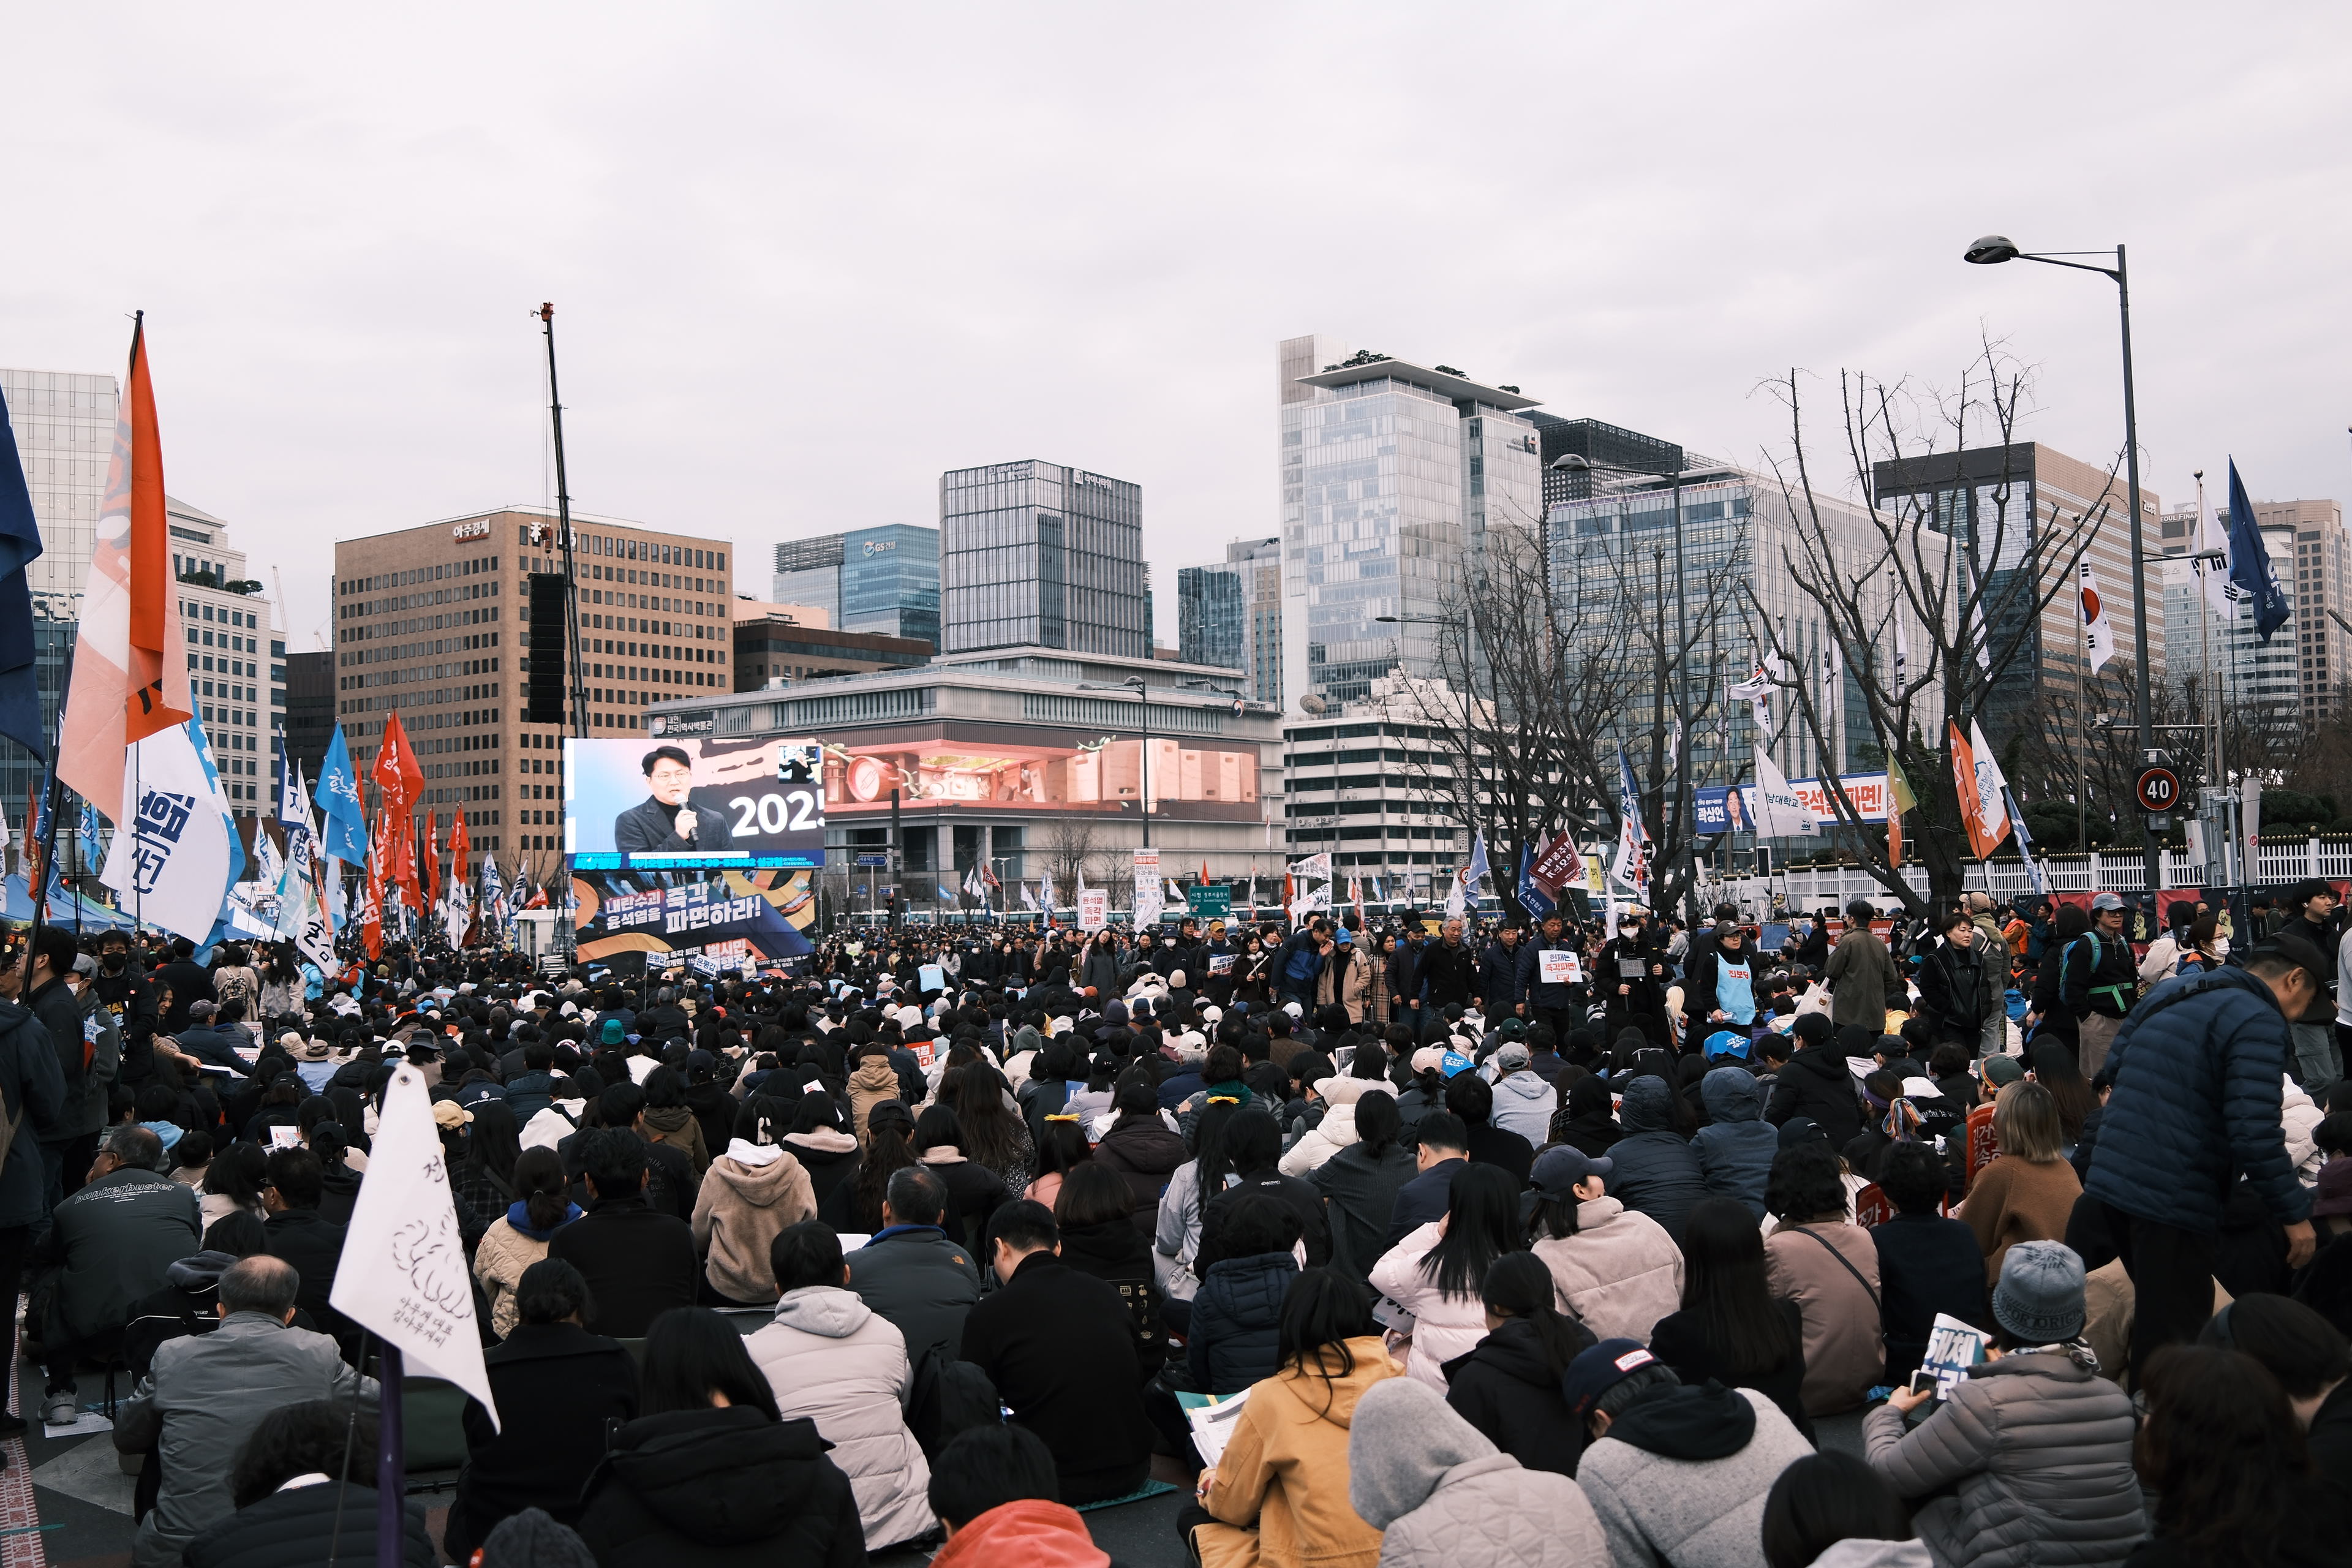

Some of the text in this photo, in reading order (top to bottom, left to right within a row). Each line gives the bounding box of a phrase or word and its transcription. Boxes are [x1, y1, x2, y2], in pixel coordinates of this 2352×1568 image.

[1085, 473, 1112, 490] 라이나타워
[453, 519, 489, 538] 아주경제
[668, 715, 679, 724] 대한
[668, 720, 713, 733] 민국 역사박물관
[2147, 780, 2169, 799] 40
[1844, 784, 1882, 813] 파면!
[1698, 806, 1725, 823] 곽상언
[606, 881, 710, 914] 내란수괴 즉각
[606, 895, 761, 933] 윤석열을 파면하라!
[1085, 916, 1101, 925] 파면
[685, 946, 702, 957] 퇴진!
[706, 938, 746, 957] 범시민
[647, 954, 665, 964] 은평갑
[696, 957, 716, 971] 은평갑
[1545, 962, 1577, 971] 즉각파면!
[1550, 954, 1570, 962] 헌재는
[1728, 970, 1749, 979] 진보당
[1973, 1123, 1998, 1150] 김건
[423, 1155, 445, 1183] 전
[75, 1182, 175, 1204] bunkerbuster
[399, 1297, 453, 1336] 아무개 대표
